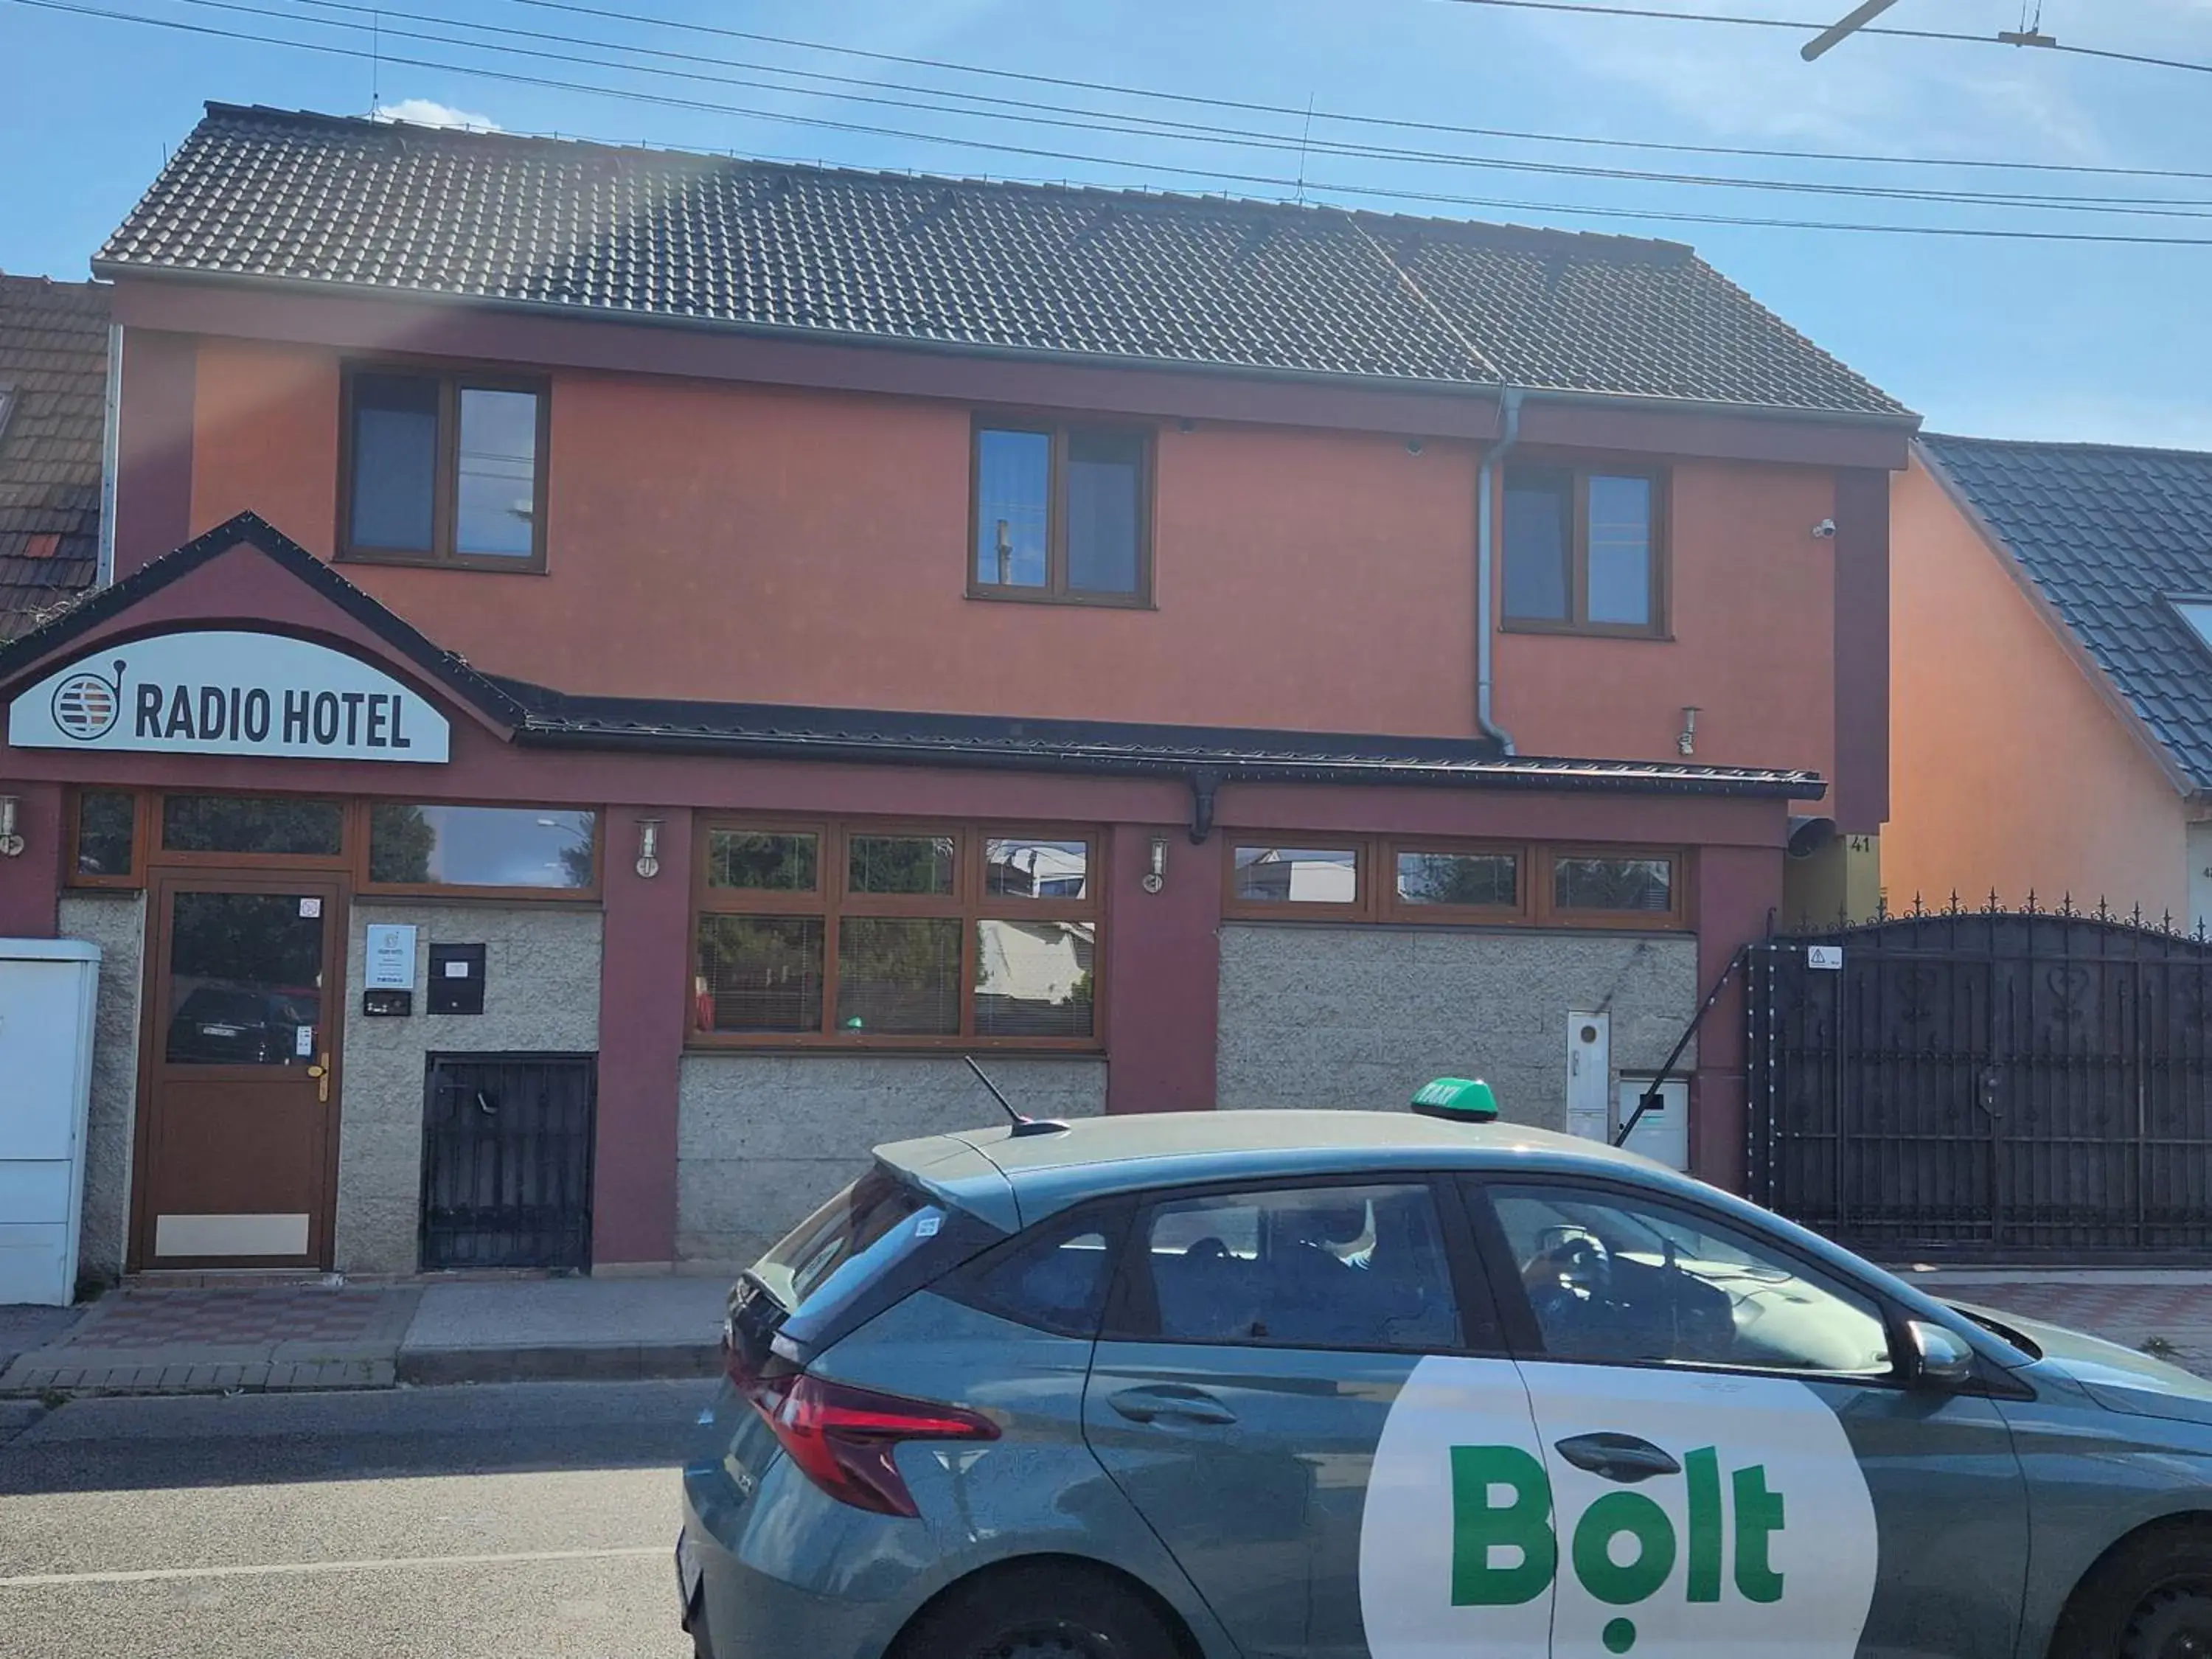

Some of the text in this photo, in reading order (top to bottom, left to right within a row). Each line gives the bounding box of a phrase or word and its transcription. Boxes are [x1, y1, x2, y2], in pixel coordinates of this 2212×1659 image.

[136, 684, 411, 748] RADIO HOTEL
[1851, 836, 1869, 852] 41
[1450, 1446, 1784, 1606] Bolt
